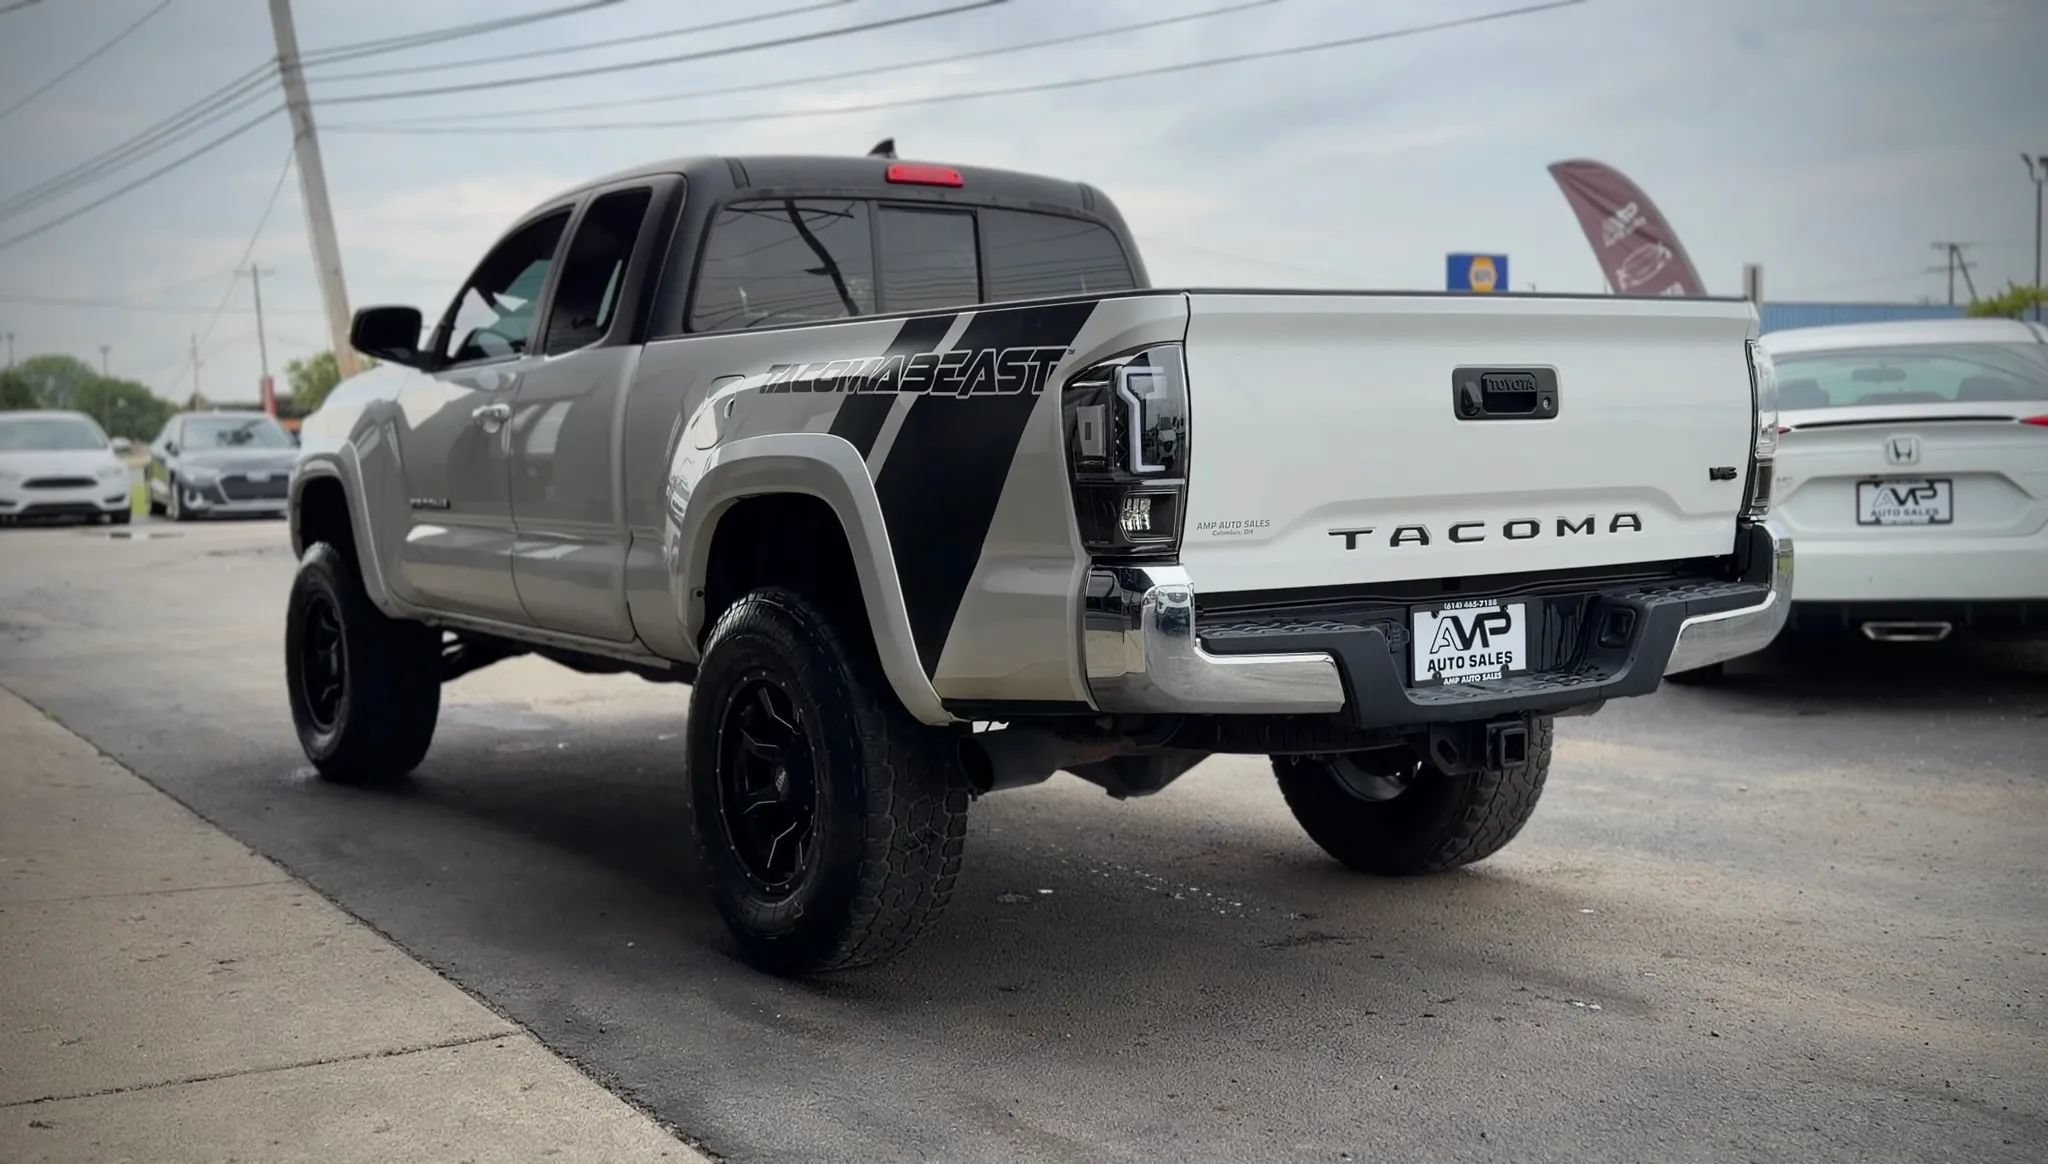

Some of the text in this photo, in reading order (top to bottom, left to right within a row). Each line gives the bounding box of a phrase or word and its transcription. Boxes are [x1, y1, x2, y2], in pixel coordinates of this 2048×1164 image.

[1488, 378, 1535, 391] TOYOTA
[1708, 466, 1738, 481] V6
[1870, 507, 1939, 518] AUTO SALES
[1196, 519, 1270, 530] AMP AUTO SALES
[1327, 511, 1644, 550] TACOMA
[1429, 610, 1512, 655] AMP
[1427, 651, 1513, 673] AUTO SALES
[1443, 671, 1502, 685] AMP AUTO SALES
